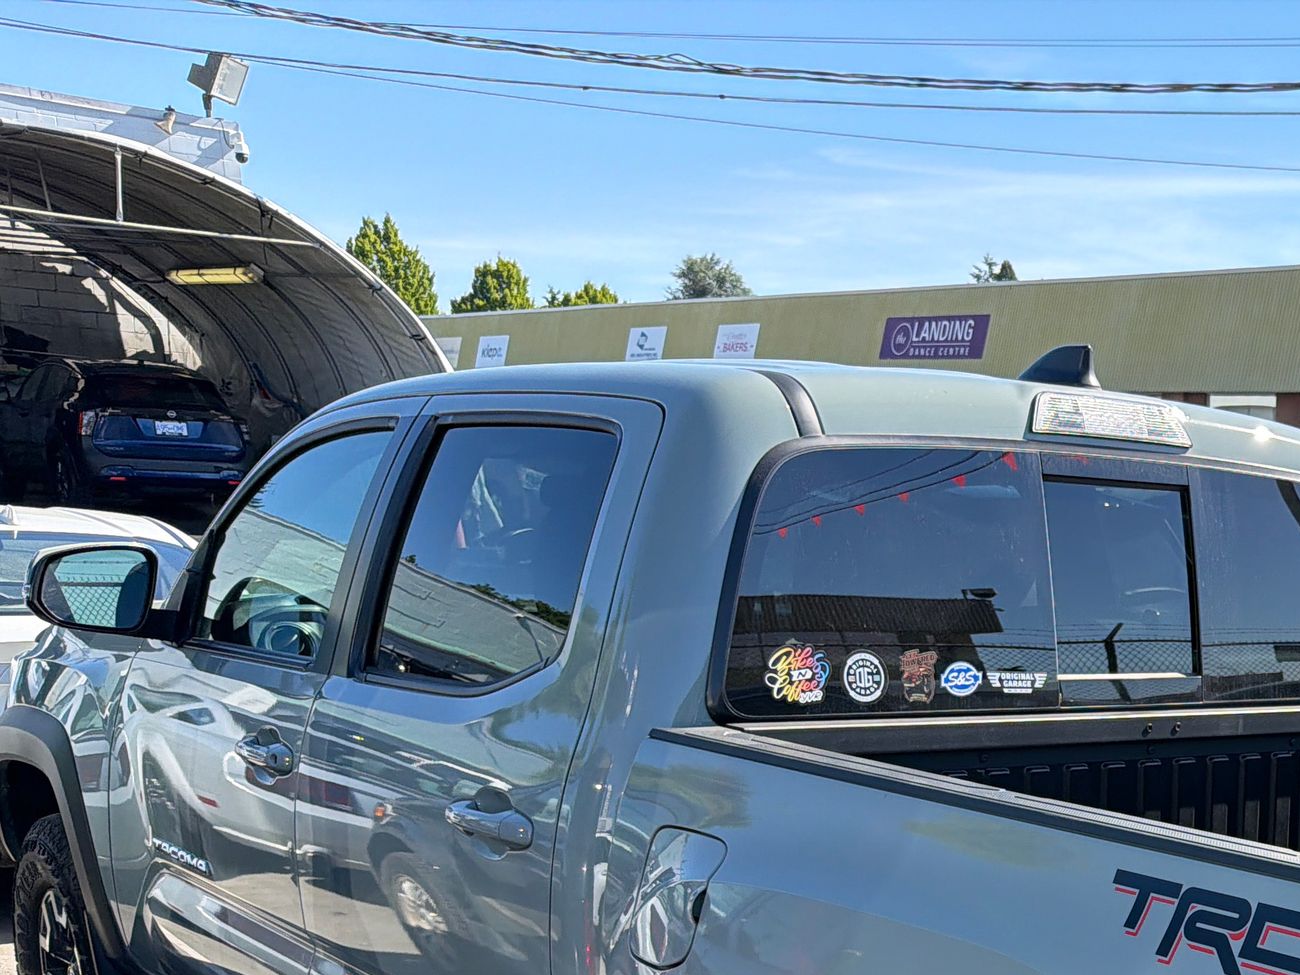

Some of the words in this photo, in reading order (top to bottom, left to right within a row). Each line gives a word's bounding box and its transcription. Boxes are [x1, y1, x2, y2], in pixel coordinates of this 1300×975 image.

[912, 320, 975, 341] LANDING
[909, 347, 936, 356] DANCE
[938, 347, 970, 356] CENTRE
[849, 660, 878, 675] ORIGINAL
[947, 671, 976, 686] S&S
[1001, 673, 1035, 681] ORIGINAL
[851, 683, 879, 695] GARAGE
[1003, 680, 1032, 688] GARAGE
[153, 837, 209, 873] TACOMA
